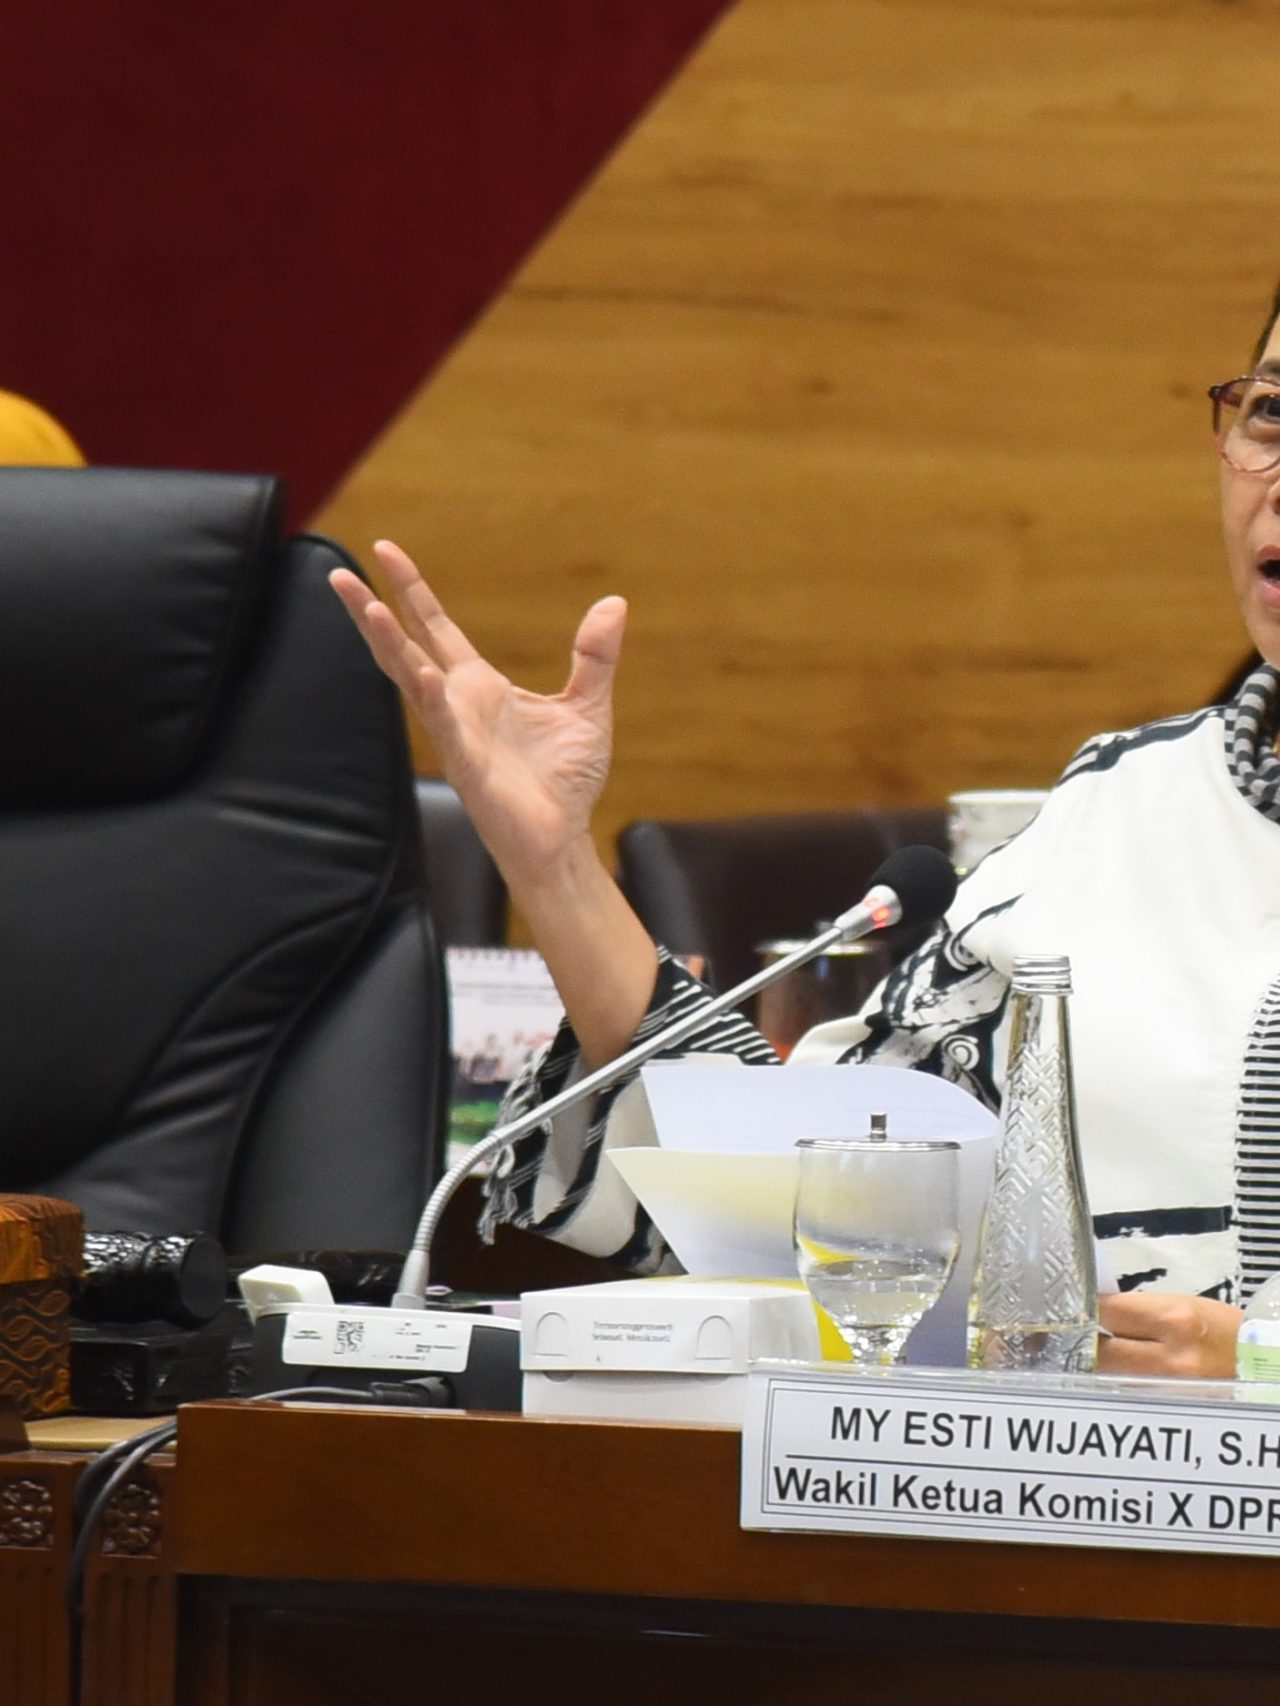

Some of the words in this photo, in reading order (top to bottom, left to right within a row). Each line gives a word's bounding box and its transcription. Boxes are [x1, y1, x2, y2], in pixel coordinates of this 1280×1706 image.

[830, 1406, 892, 1442] MY
[903, 1410, 993, 1450] ESTI
[1006, 1417, 1202, 1470] WIJAYATI,
[773, 1465, 877, 1507] Wakil
[892, 1473, 1003, 1515] Ketua
[1018, 1481, 1153, 1525] Komisi
[1166, 1491, 1194, 1528] X
